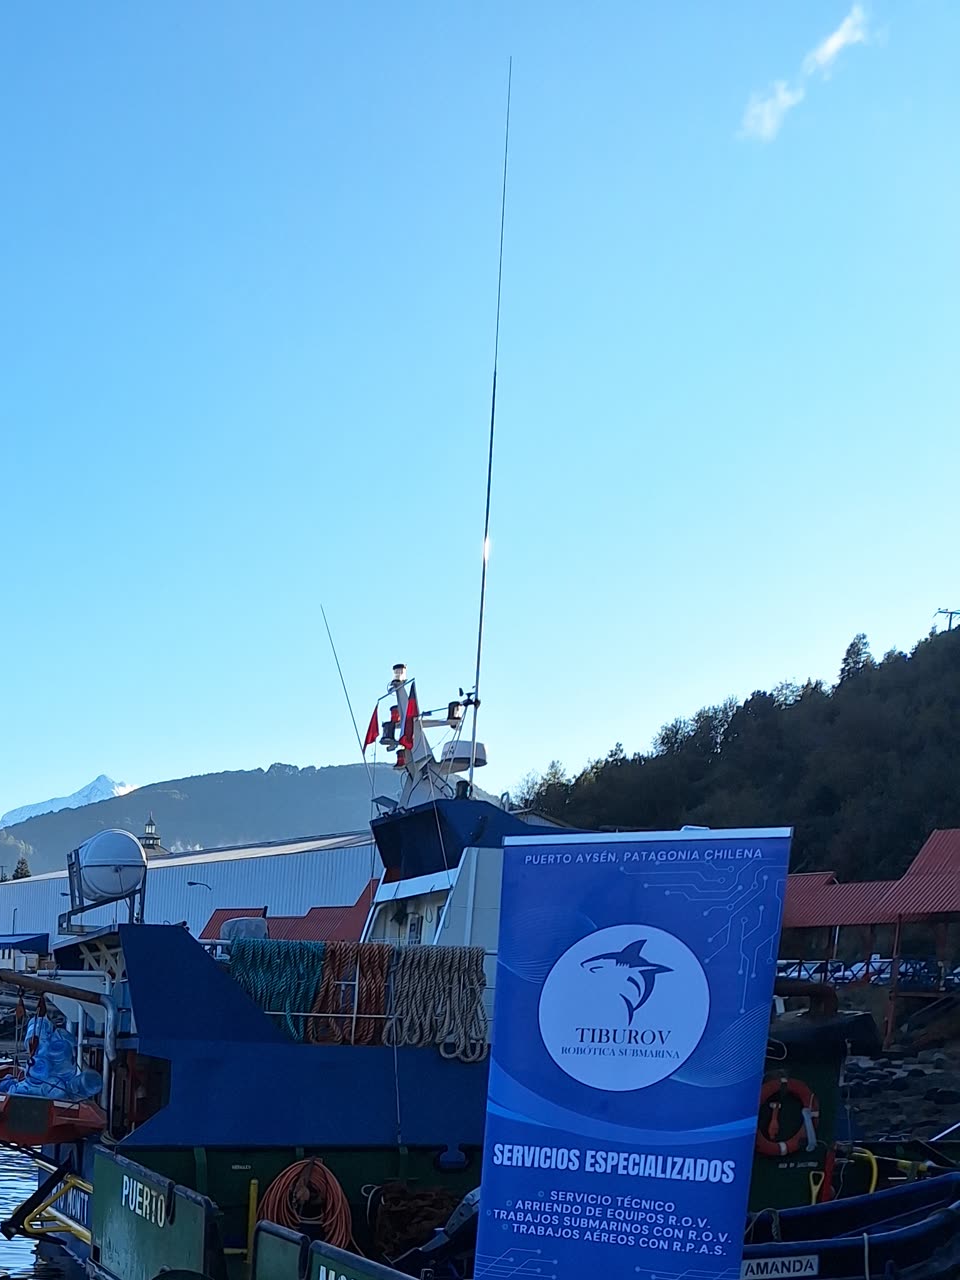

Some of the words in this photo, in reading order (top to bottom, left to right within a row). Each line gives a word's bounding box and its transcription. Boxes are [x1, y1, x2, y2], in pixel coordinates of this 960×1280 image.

[525, 854, 572, 865] PUERTO
[575, 851, 619, 864] AYSÉN,
[623, 850, 700, 862] PATAGONIA
[704, 848, 763, 861] CHILENA
[576, 1028, 671, 1045] TIBUROV
[561, 1046, 615, 1057] ROBÓTICA
[618, 1048, 680, 1059] SUBMARINA
[493, 1143, 581, 1171] SERVICIOS
[585, 1150, 735, 1184] ESPECIALIZADOS
[121, 1174, 166, 1228] PUERTO
[515, 1199, 582, 1215] ARRIENDO
[585, 1207, 603, 1217] DE
[606, 1209, 665, 1225] EQUIPOS
[668, 1216, 712, 1229] R.O.V.
[550, 1190, 612, 1206] SERVICIO
[616, 1194, 675, 1212] TÉCNICO
[493, 1209, 560, 1225] TRABAJOS
[563, 1216, 649, 1235] SUBMARINOS
[652, 1226, 684, 1239] CON
[688, 1230, 732, 1243] R.O.V.
[512, 1223, 580, 1240] TRABAJOS
[583, 1229, 635, 1246] AÉREOS
[638, 1237, 669, 1250] CON
[672, 1242, 727, 1256] R.P.A.S.
[744, 1259, 815, 1277] AMANDA
